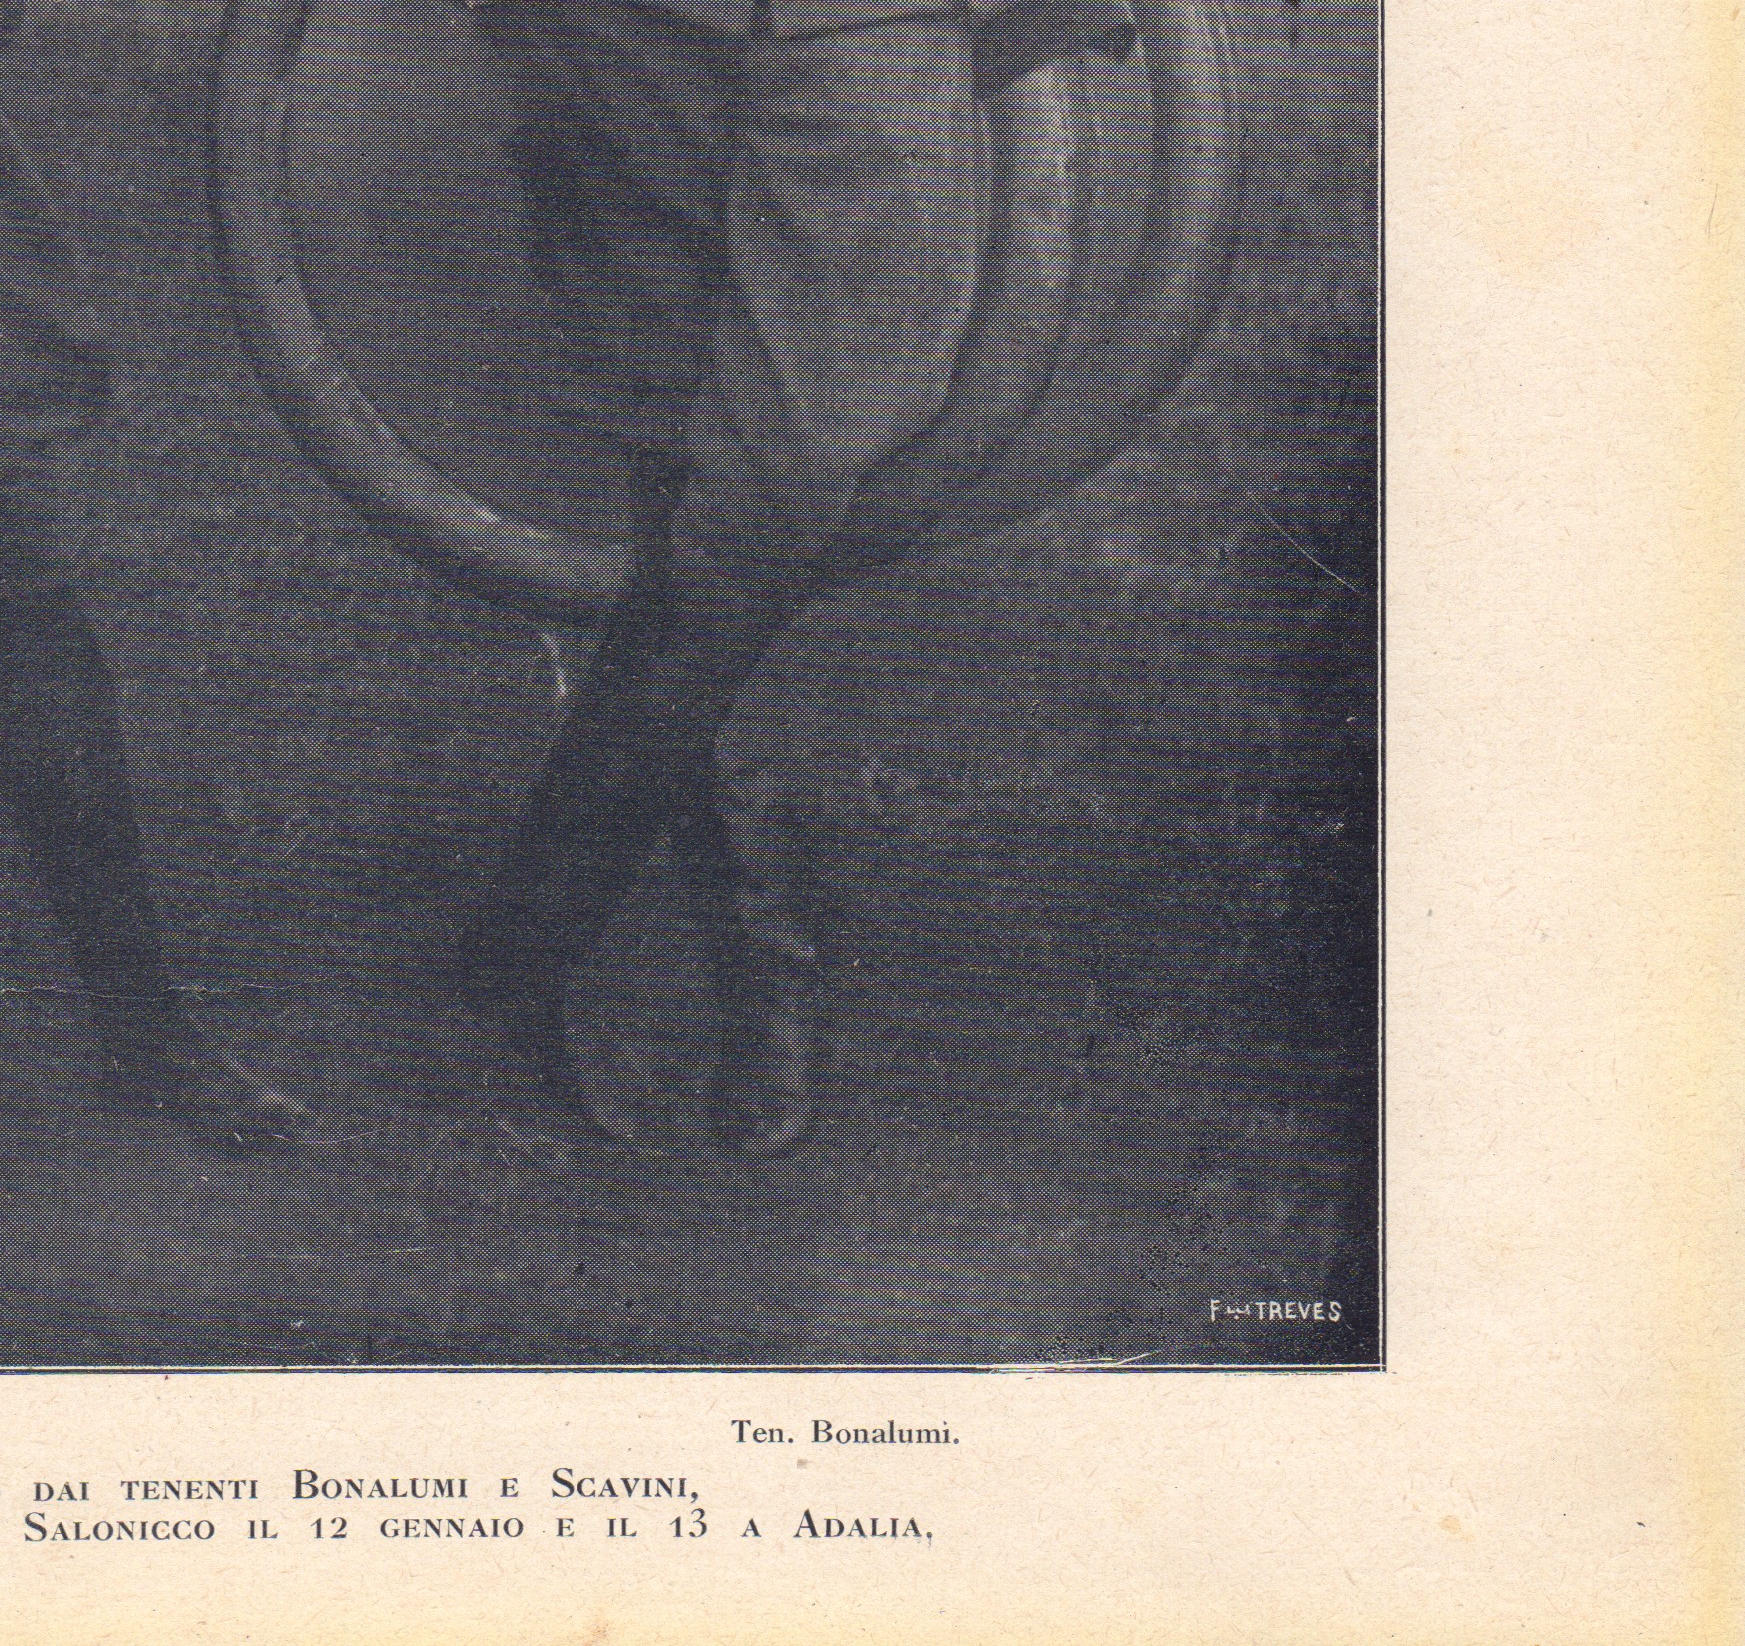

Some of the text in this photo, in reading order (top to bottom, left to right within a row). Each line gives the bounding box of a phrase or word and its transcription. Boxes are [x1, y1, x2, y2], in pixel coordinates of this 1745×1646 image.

[1254, 1298, 1344, 1324] TREVES
[731, 1419, 960, 1445] Ten. Bonalumi.
[312, 1516, 347, 1539] 12
[669, 1507, 708, 1538] 13
